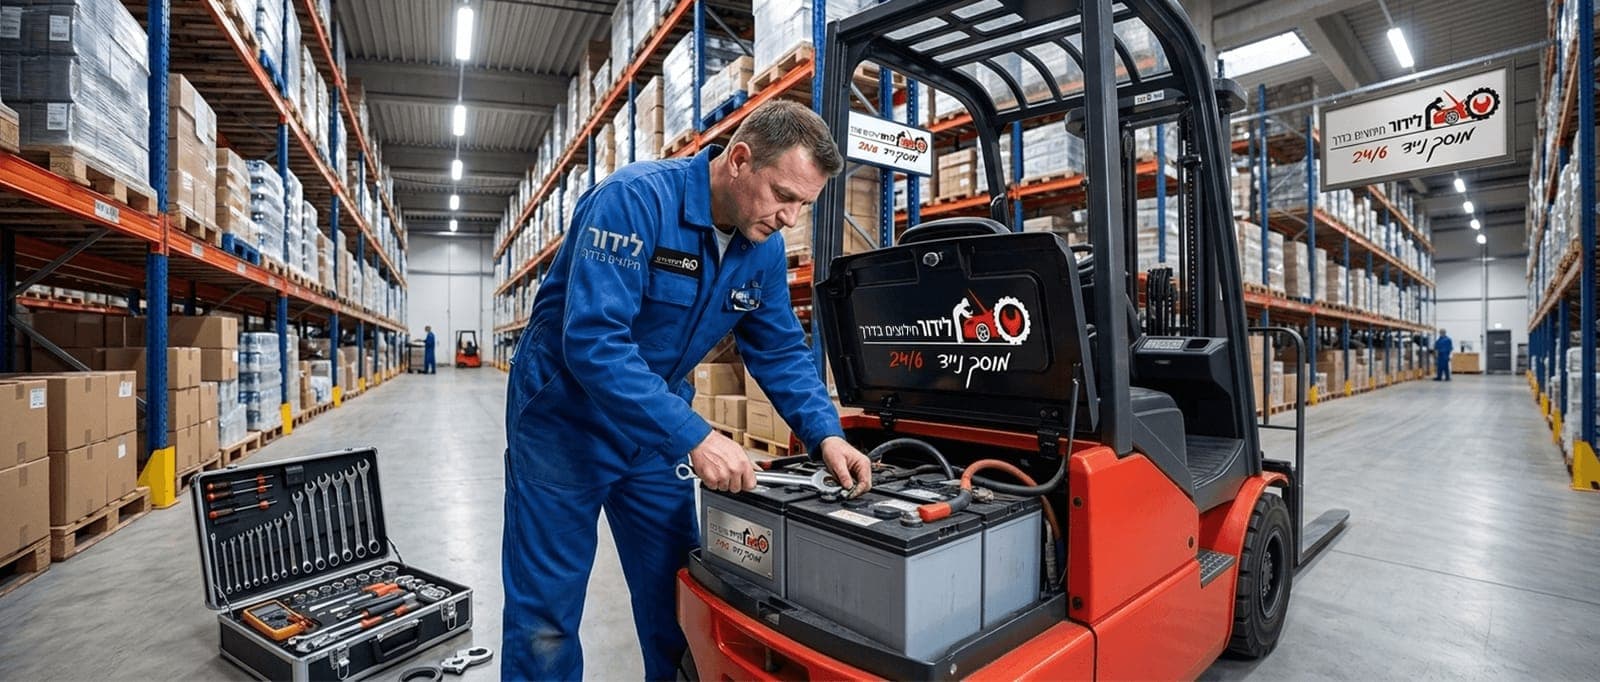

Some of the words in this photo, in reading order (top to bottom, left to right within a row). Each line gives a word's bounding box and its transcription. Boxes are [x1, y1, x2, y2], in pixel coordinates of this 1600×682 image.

[1388, 114, 1423, 133] לידור
[1401, 138, 1428, 155] נייד
[1426, 126, 1476, 163] מוסך
[1352, 145, 1388, 164] 24/6
[588, 226, 644, 257] לידור
[859, 325, 883, 340] בדרך
[885, 323, 919, 337] חילוצים
[916, 316, 952, 337] לידור
[889, 351, 924, 370] 24/6
[937, 353, 964, 374] נייד
[965, 352, 1012, 389] מוסך
